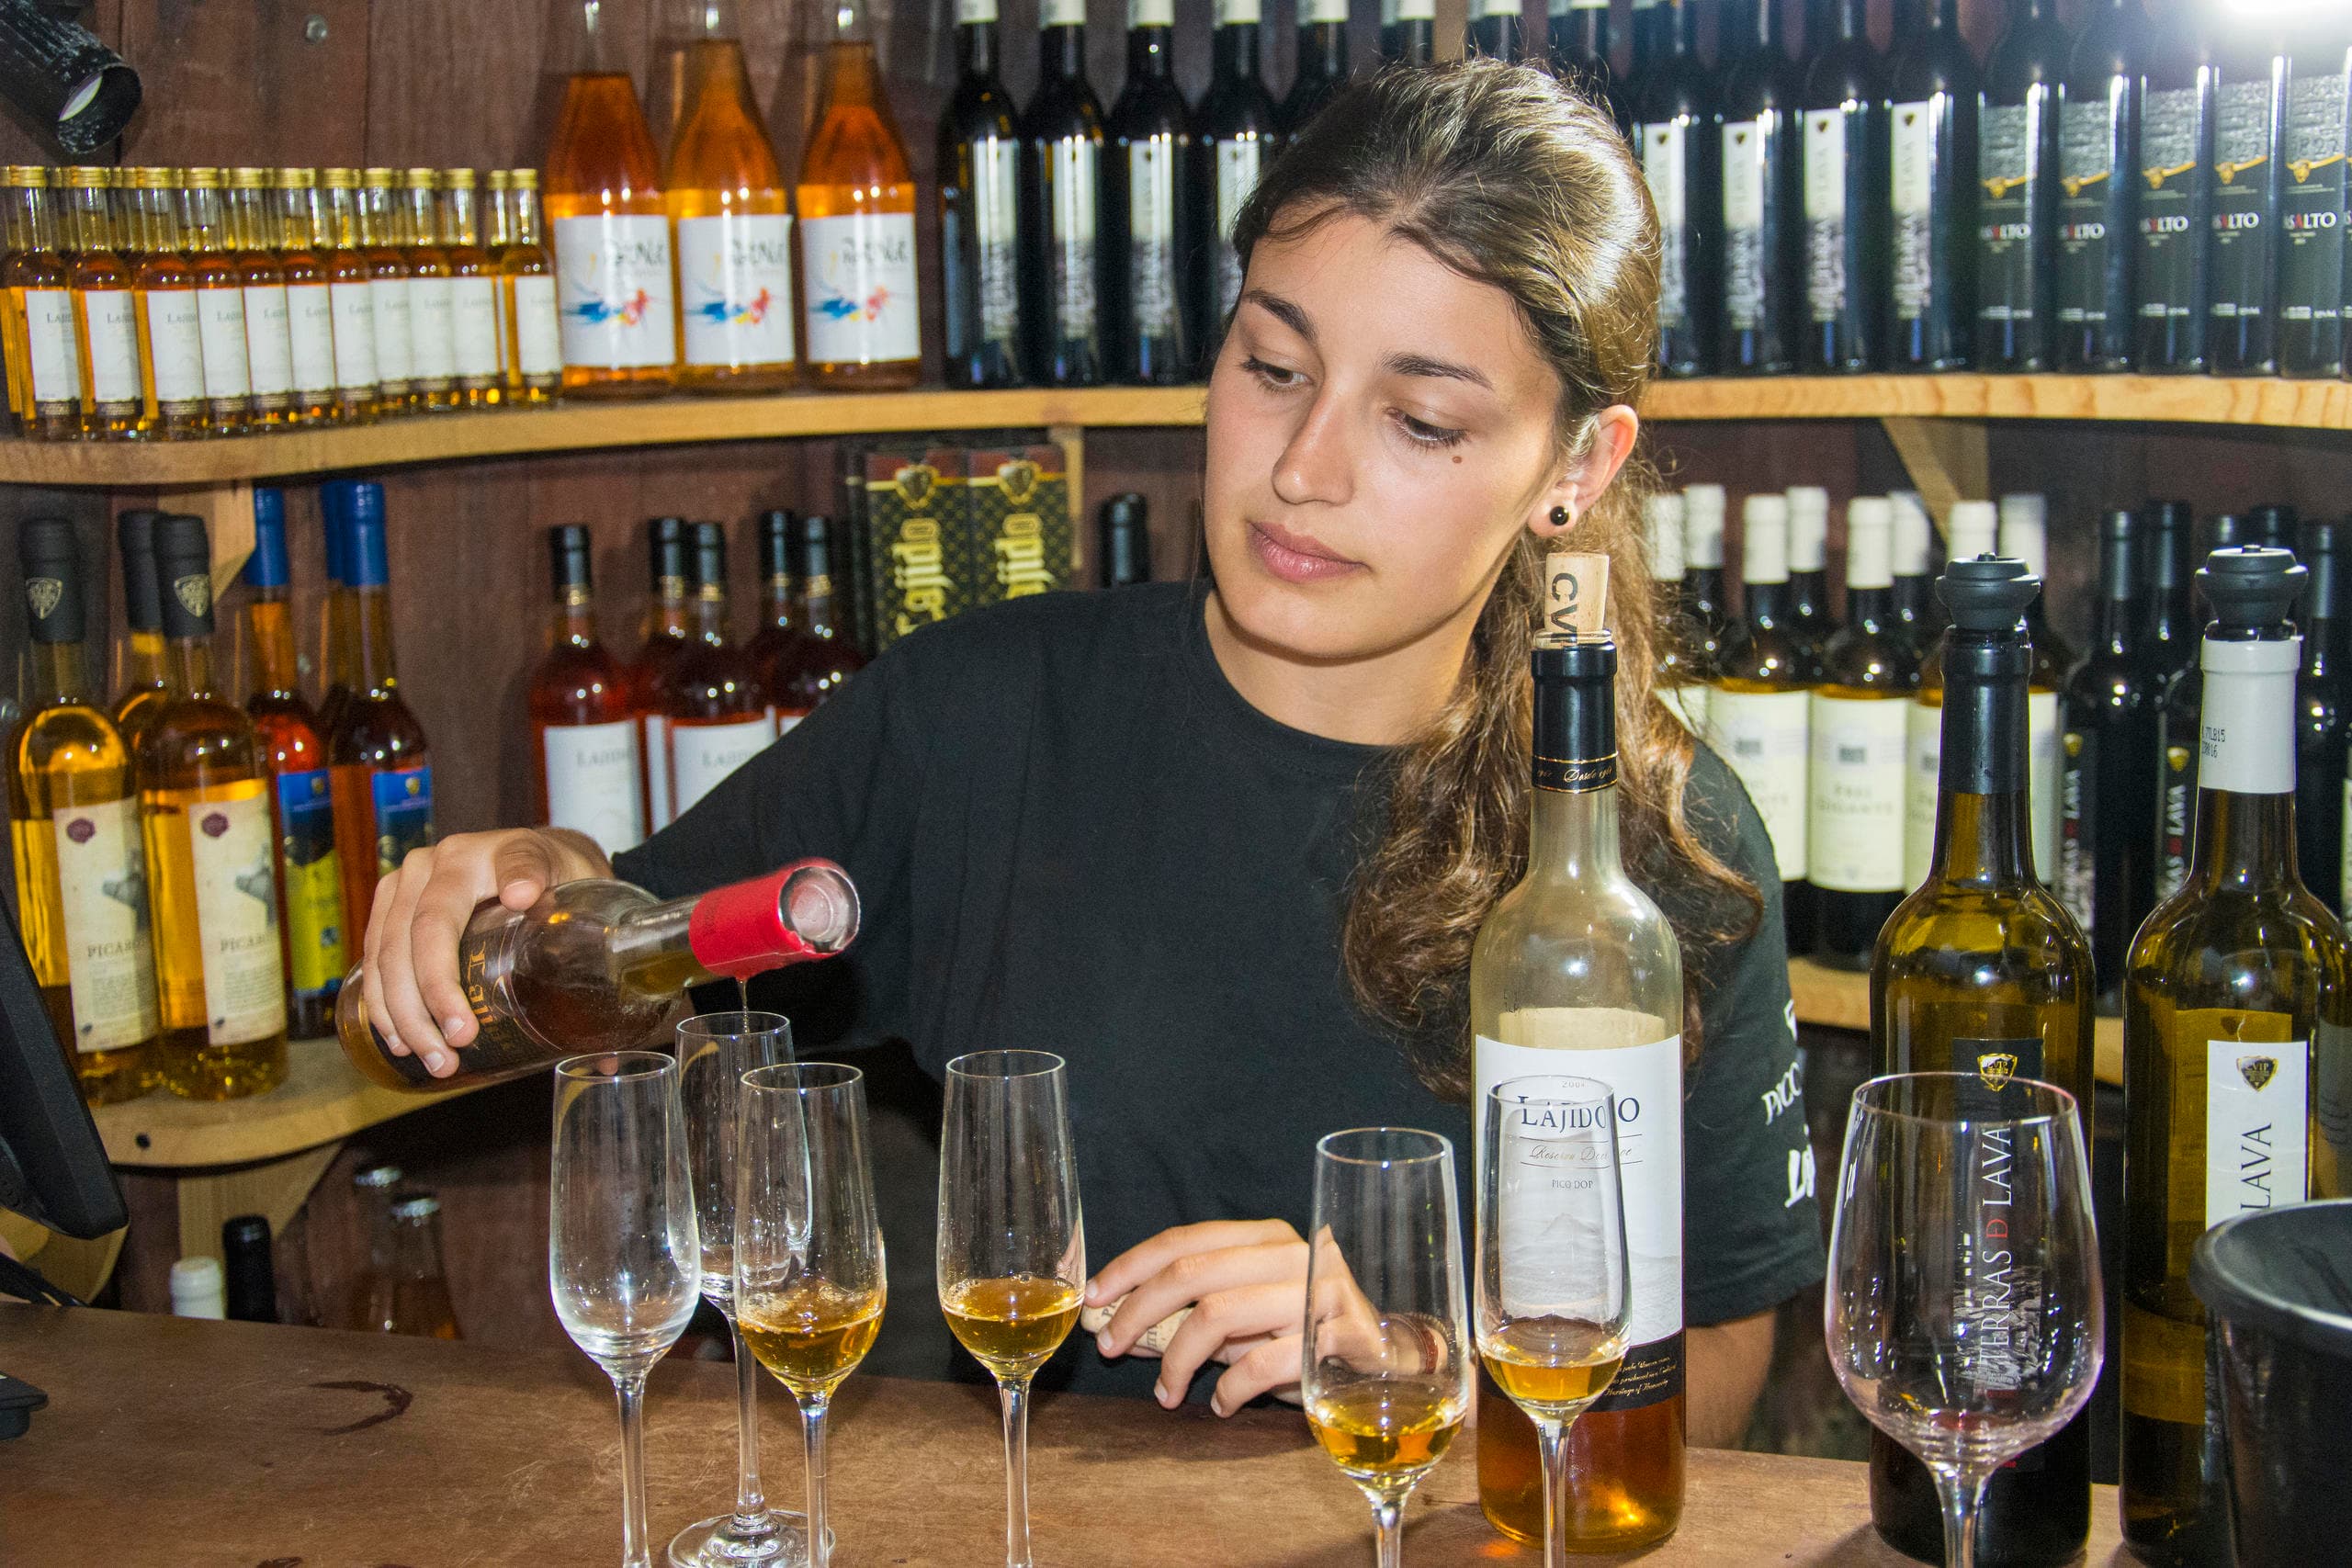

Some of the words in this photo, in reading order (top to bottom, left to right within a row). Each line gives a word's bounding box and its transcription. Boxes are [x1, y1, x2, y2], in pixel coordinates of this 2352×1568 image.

[1982, 1119, 2012, 1207] LAVA
[2240, 1122, 2272, 1211] LAVA
[1978, 1250, 2013, 1365] TERRAS
